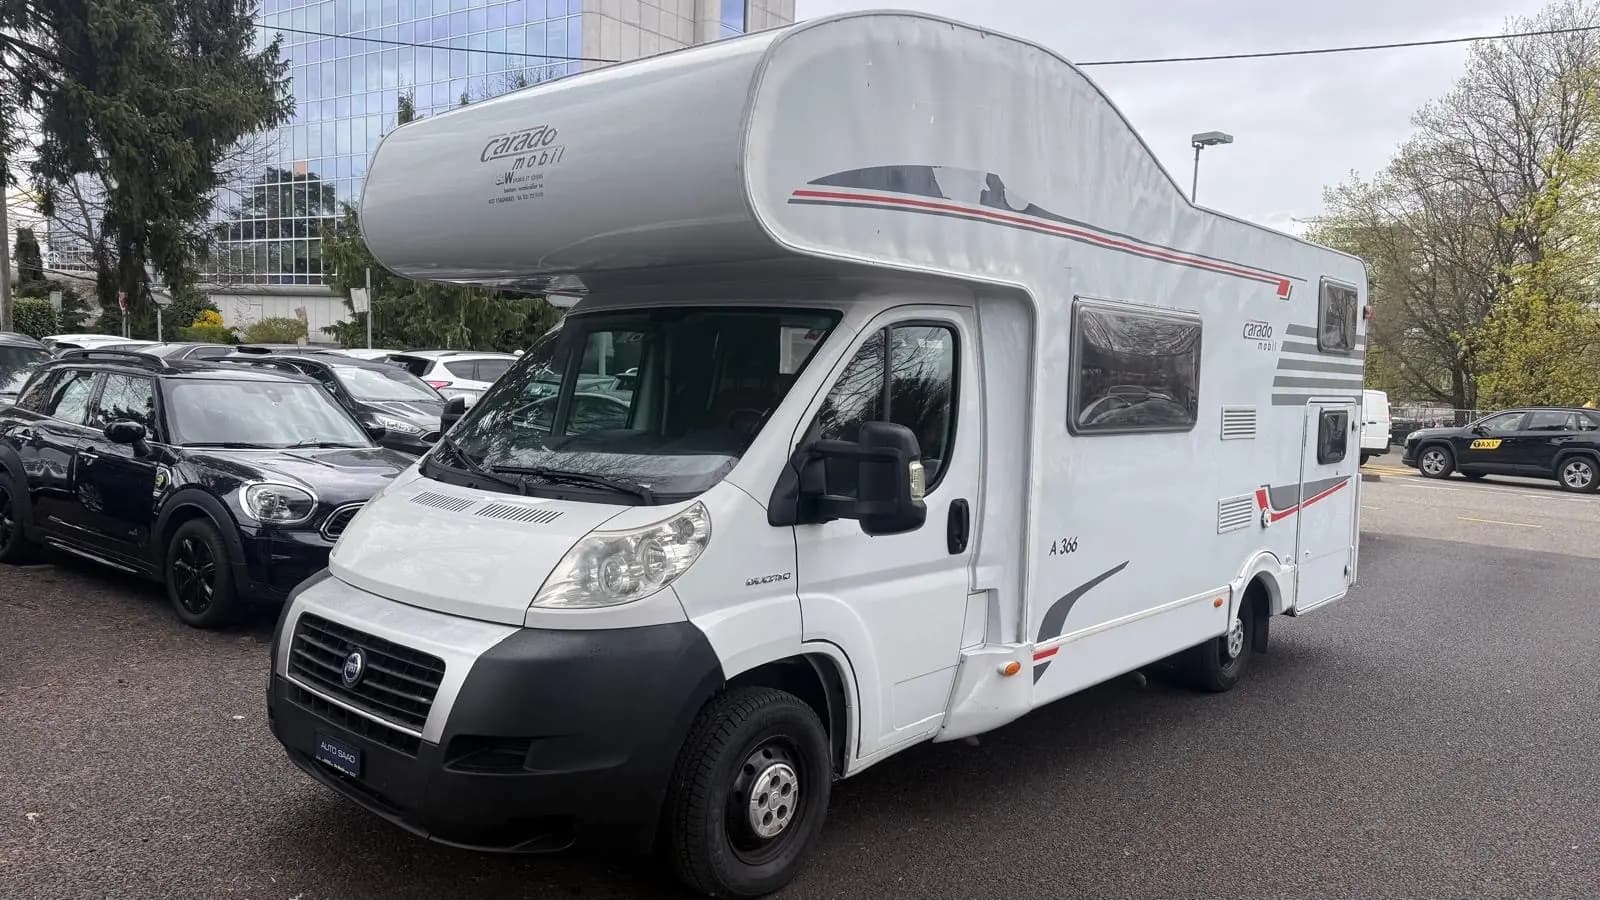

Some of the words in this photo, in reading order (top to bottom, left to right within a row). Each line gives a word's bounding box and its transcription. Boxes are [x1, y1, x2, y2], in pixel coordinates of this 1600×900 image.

[511, 145, 566, 170] mobil
[1049, 540, 1057, 556] A
[1060, 536, 1078, 555] 366
[320, 740, 337, 755] AUTO
